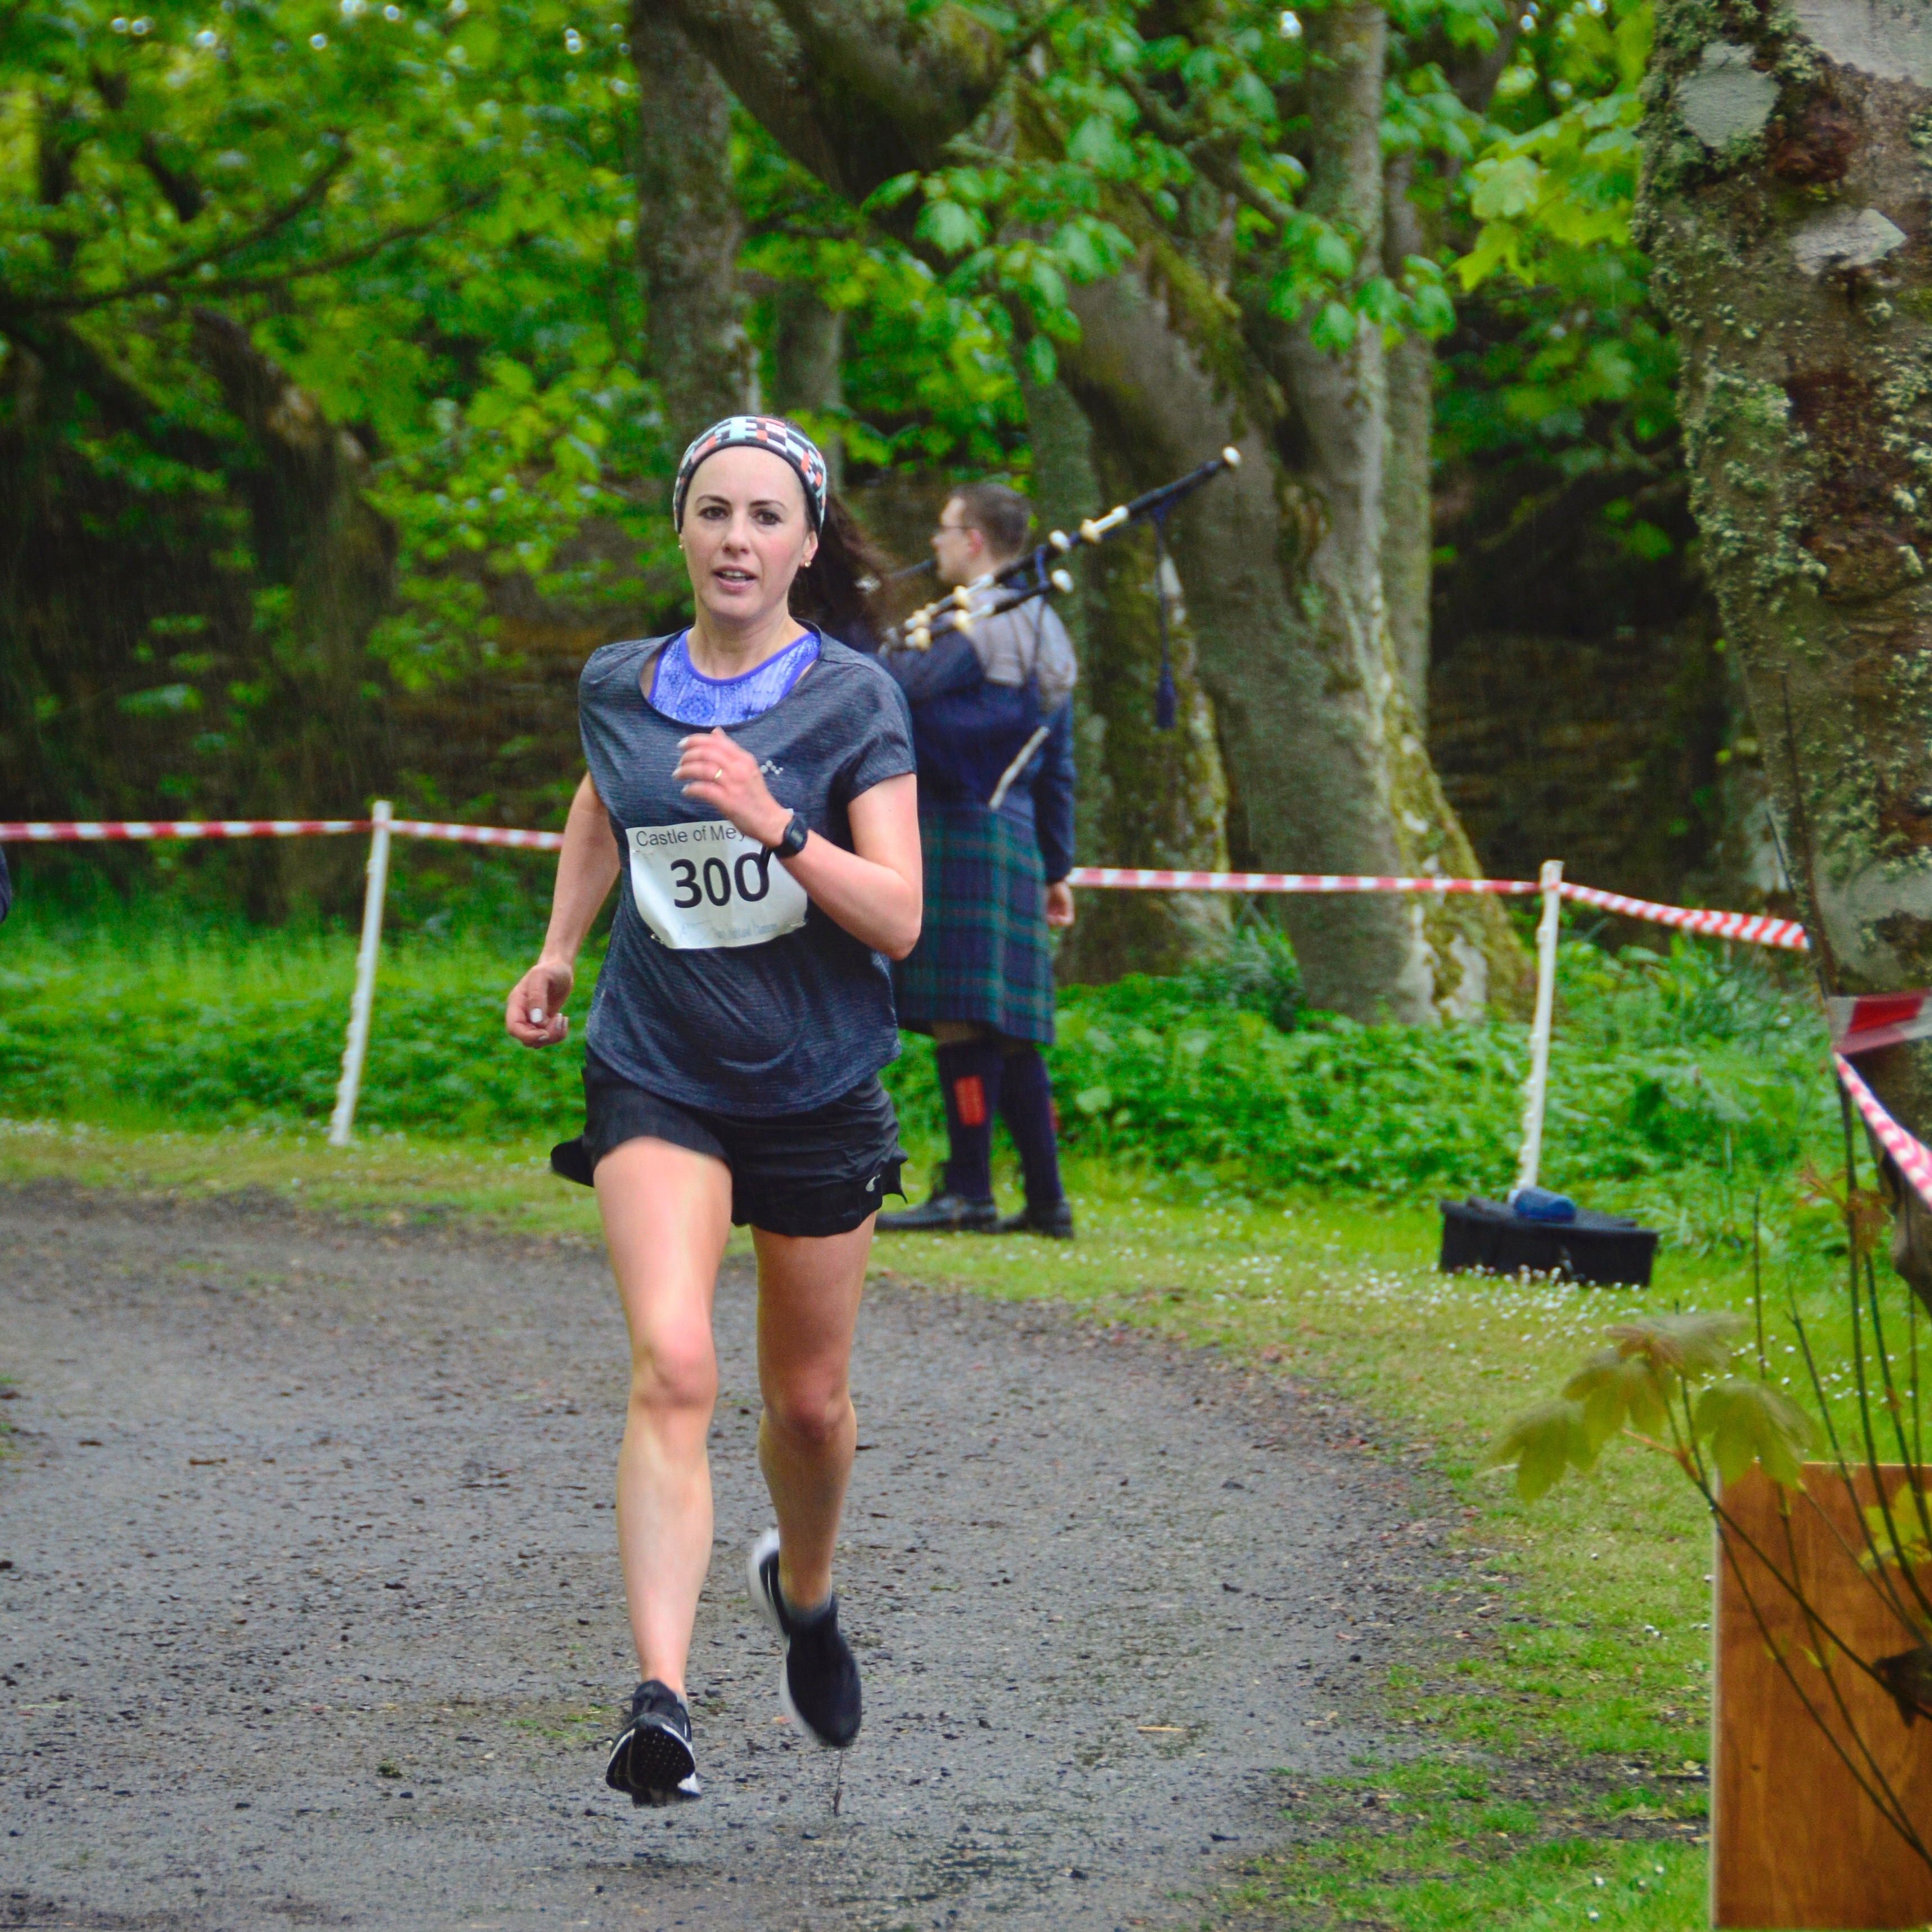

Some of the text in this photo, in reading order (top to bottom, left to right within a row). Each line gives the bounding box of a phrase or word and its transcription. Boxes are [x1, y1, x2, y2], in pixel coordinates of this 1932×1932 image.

[636, 829, 688, 847] Castle
[693, 825, 706, 841] of
[670, 852, 770, 908] 300
